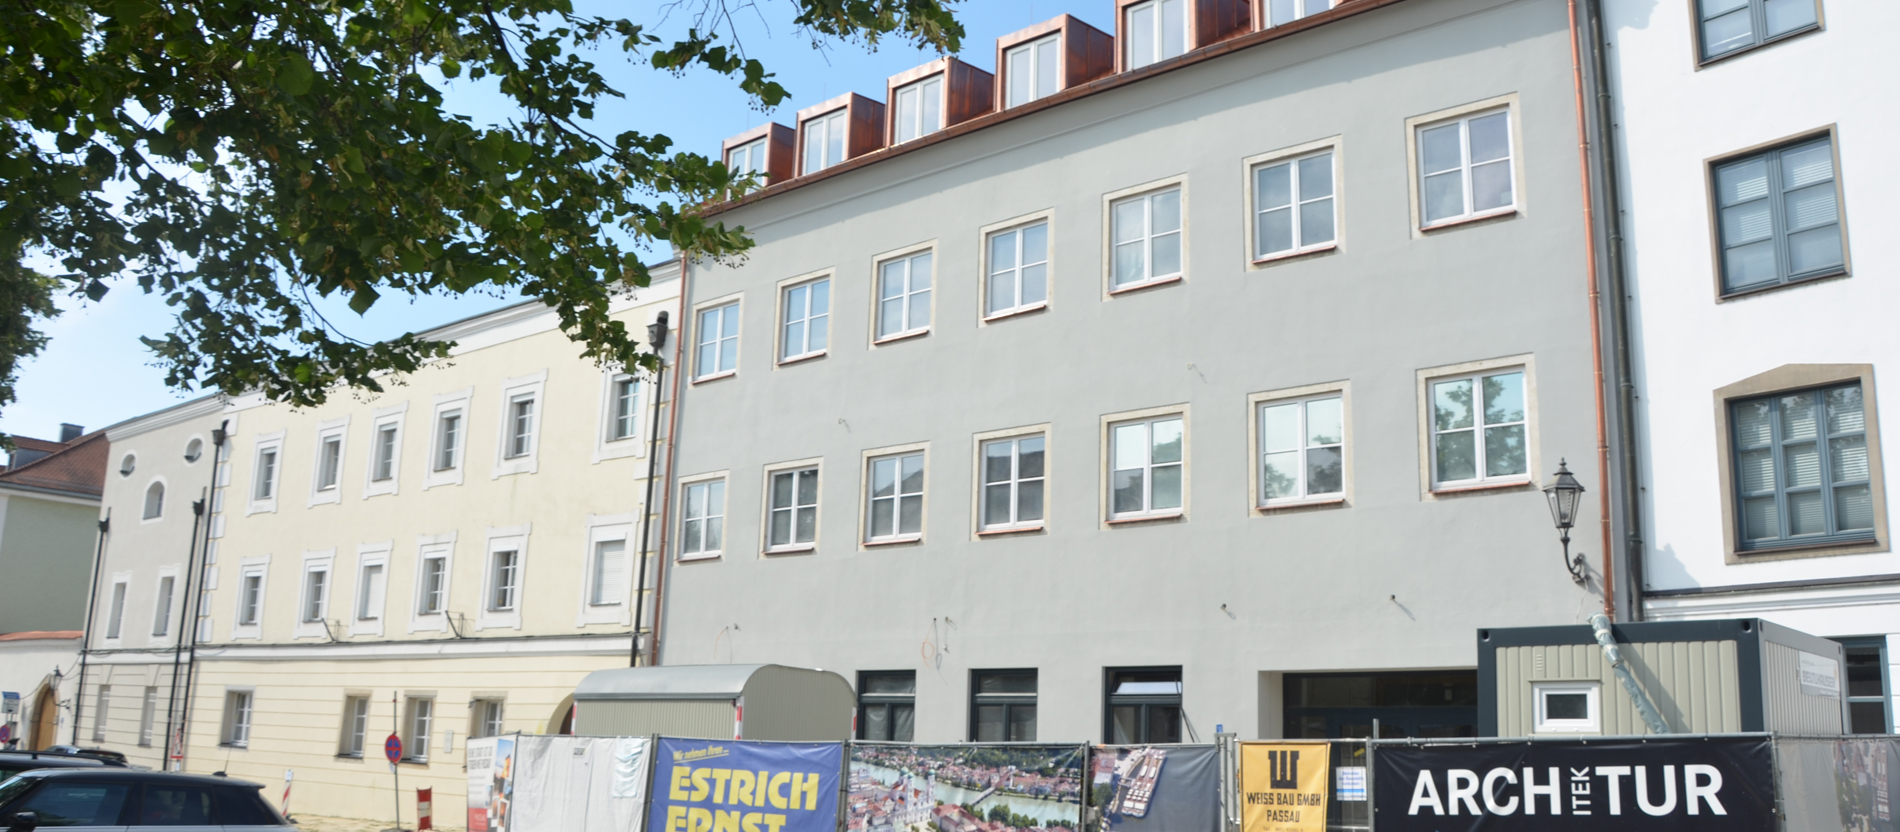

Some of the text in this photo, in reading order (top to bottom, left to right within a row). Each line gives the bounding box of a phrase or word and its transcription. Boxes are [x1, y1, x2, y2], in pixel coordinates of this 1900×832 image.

[673, 750, 685, 761] Wir
[684, 748, 707, 759] nehmen
[669, 766, 820, 811] ESTRICH
[1407, 764, 1728, 816] ARCH ITEK TUR
[1246, 792, 1321, 806] WEISS BAU GMBH
[664, 805, 787, 832] ERNST
[1266, 809, 1301, 823] PASSAU
